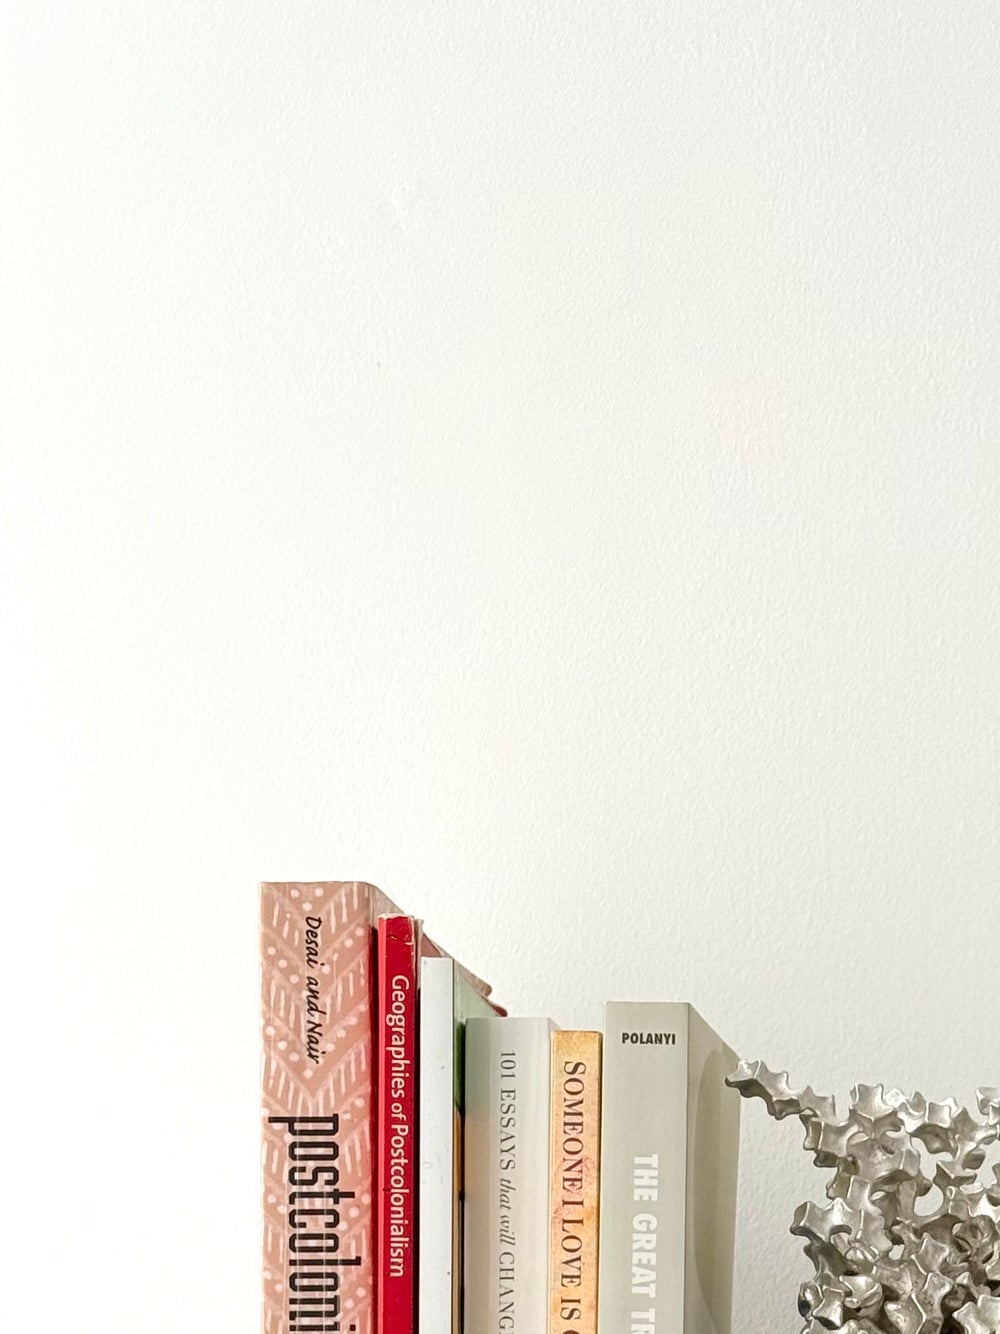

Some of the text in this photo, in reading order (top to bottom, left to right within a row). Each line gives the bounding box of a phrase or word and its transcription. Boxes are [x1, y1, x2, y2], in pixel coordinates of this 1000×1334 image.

[305, 916, 327, 1064] Desai and Nair
[621, 1032, 676, 1045] POLANYI
[500, 1051, 516, 1079] 101
[385, 975, 410, 1277] Geographies of Postcolonialism
[500, 1089, 516, 1170] ESSAYS
[562, 1061, 586, 1191] SOMEONE
[500, 1178, 516, 1213] that
[633, 1153, 659, 1202] THE
[561, 1199, 584, 1208] I
[500, 1214, 516, 1245] will
[560, 1218, 584, 1288] LOVE
[632, 1213, 658, 1298] GREAT
[560, 1298, 581, 1320] IS
